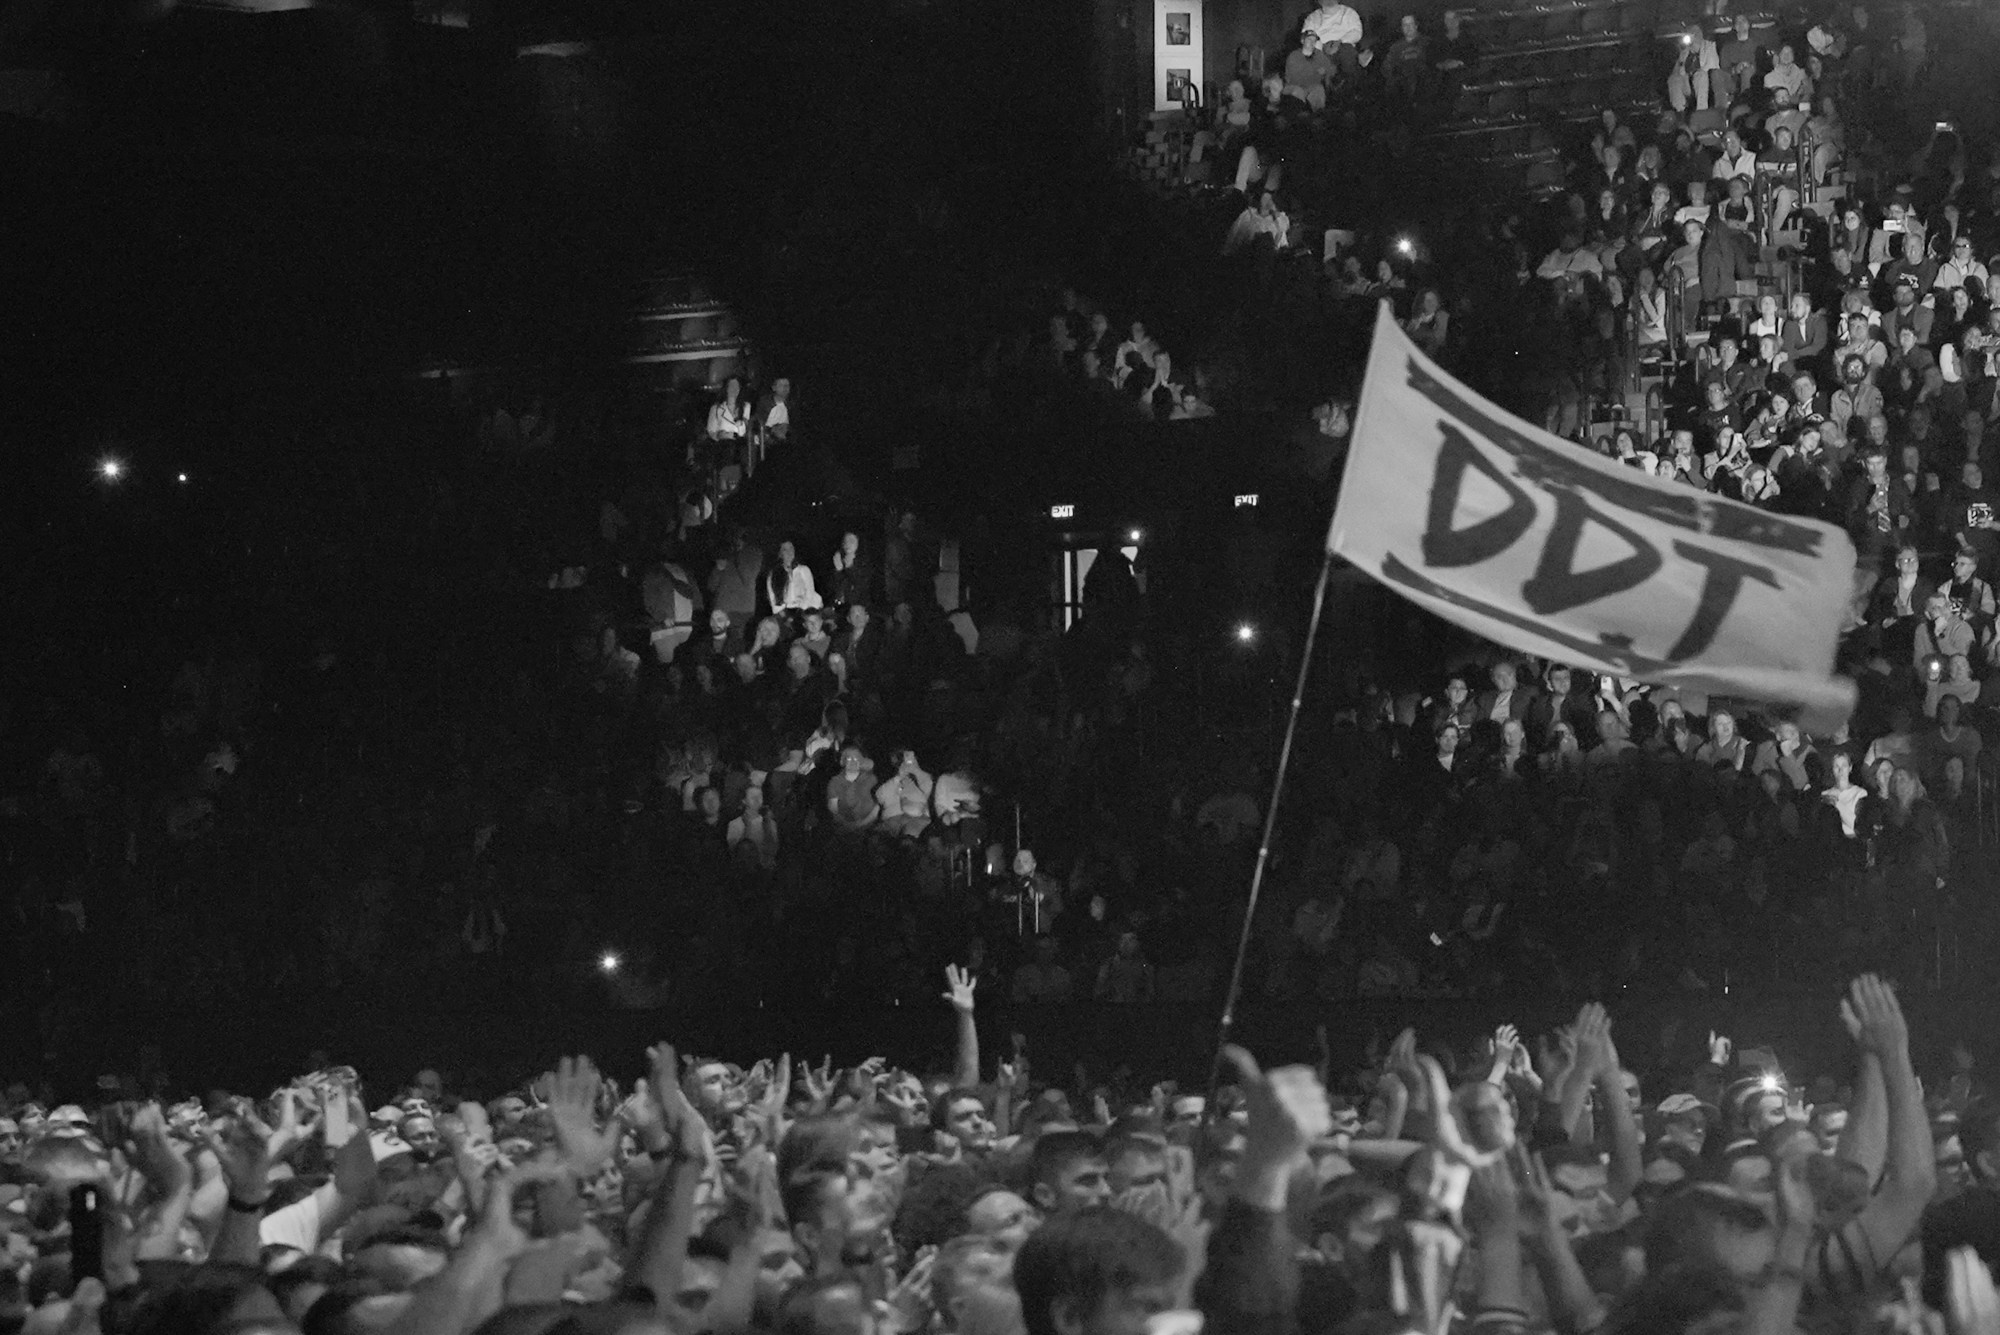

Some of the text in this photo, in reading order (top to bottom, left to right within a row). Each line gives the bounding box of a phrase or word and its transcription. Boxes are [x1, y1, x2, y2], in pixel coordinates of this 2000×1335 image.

[1235, 494, 1258, 507] EXIT
[1051, 505, 1074, 517] EXIT
[1422, 420, 1782, 662] DDT
